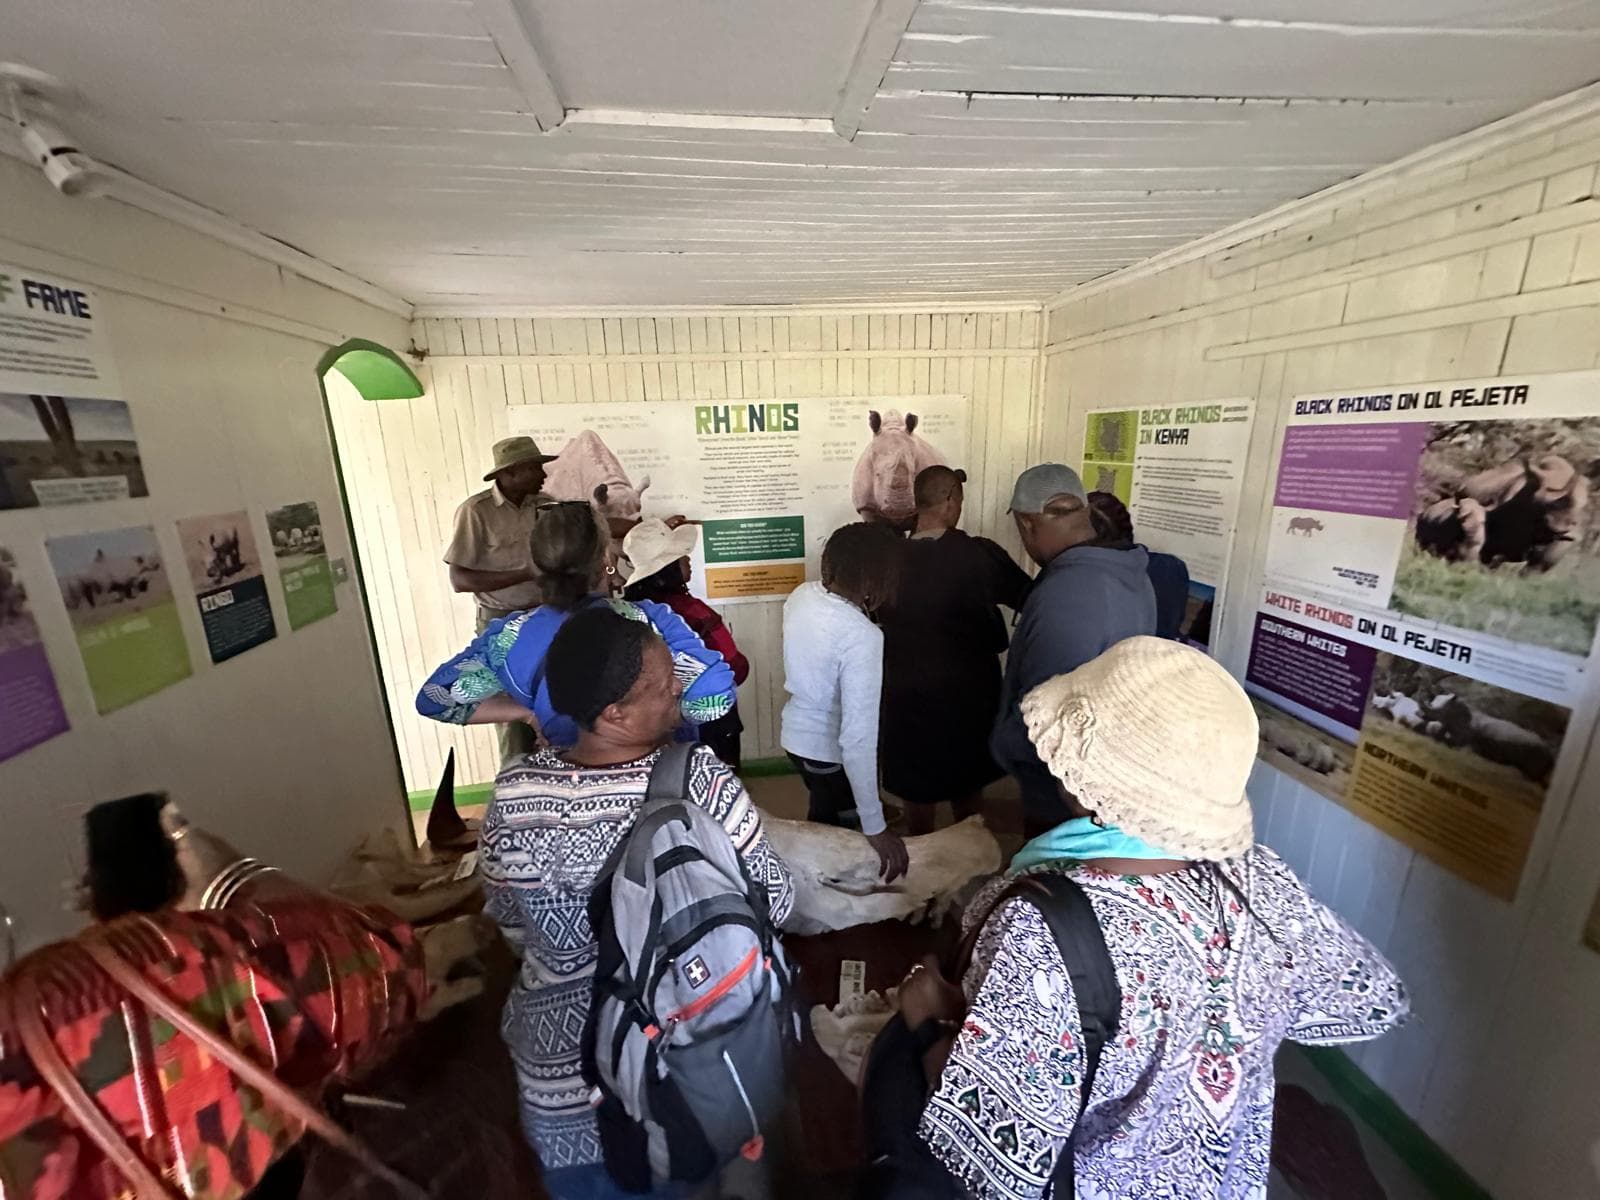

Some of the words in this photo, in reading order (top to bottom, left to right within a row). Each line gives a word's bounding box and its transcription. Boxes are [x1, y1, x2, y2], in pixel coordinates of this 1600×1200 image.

[21, 279, 92, 319] FAME
[1140, 408, 1172, 426] BLACK
[1174, 405, 1222, 425] RHINOS
[1295, 398, 1332, 416] BLACK
[1337, 394, 1393, 414] RHINOS
[1397, 393, 1418, 411] ON
[1424, 391, 1443, 409] OL
[1450, 384, 1529, 408] PEJETA
[694, 403, 799, 435] RHINOS
[1139, 429, 1152, 445] IN
[1154, 428, 1189, 445] KENYA
[1260, 619, 1306, 644] SOUTHERN
[1306, 632, 1348, 658] WHITES
[1265, 591, 1301, 614] WHITE
[1304, 603, 1354, 629] RHINOS
[1357, 618, 1377, 636] ON
[1381, 624, 1398, 643] OL
[1403, 630, 1472, 664] PEJETA
